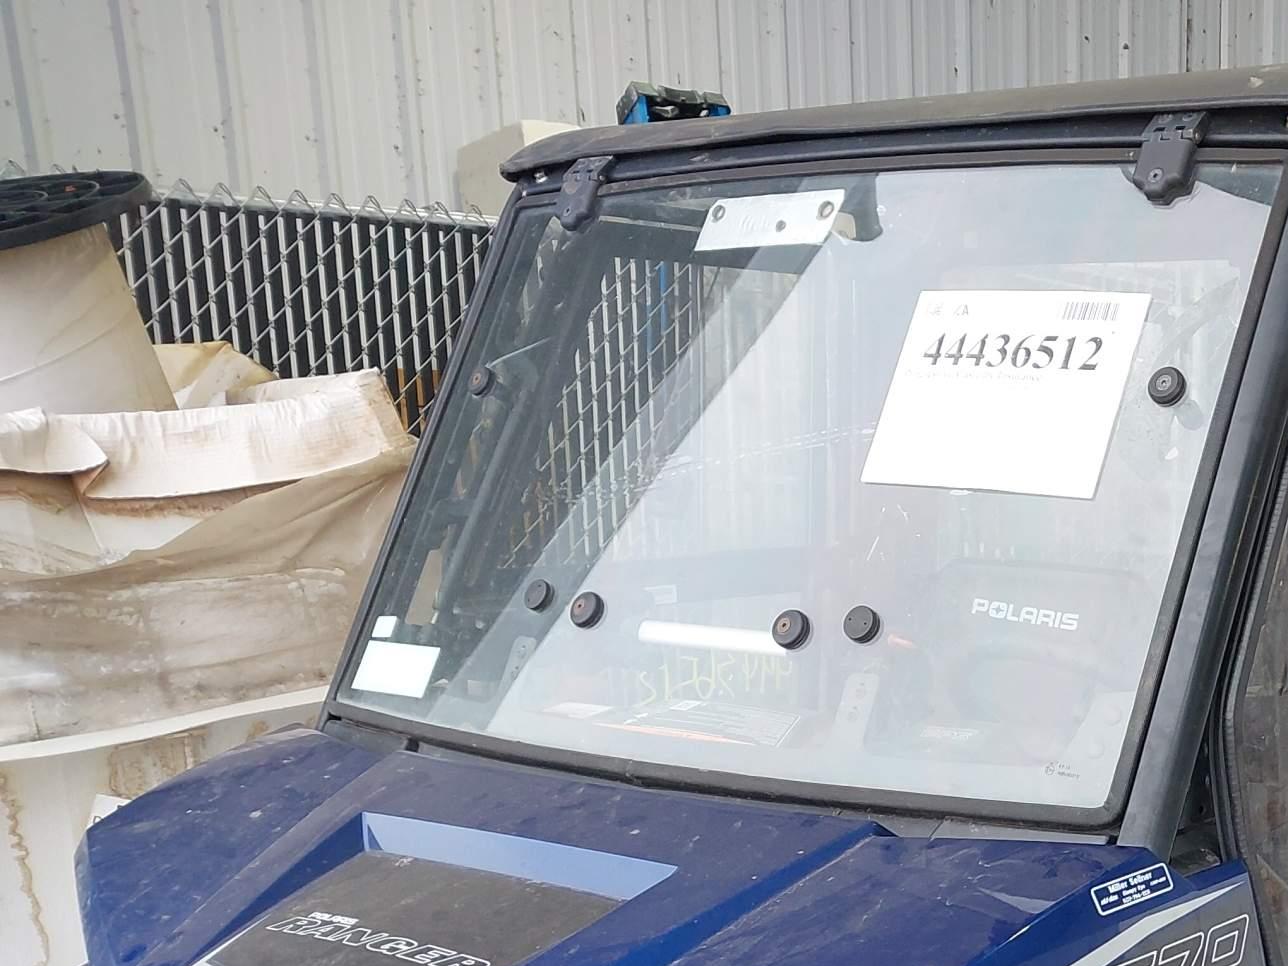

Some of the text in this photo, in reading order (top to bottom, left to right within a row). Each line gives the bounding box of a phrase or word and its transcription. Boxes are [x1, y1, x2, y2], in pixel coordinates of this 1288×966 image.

[923, 332, 1104, 371] 44436512
[971, 597, 1080, 631] POLARIS
[308, 911, 360, 925] POLARIS
